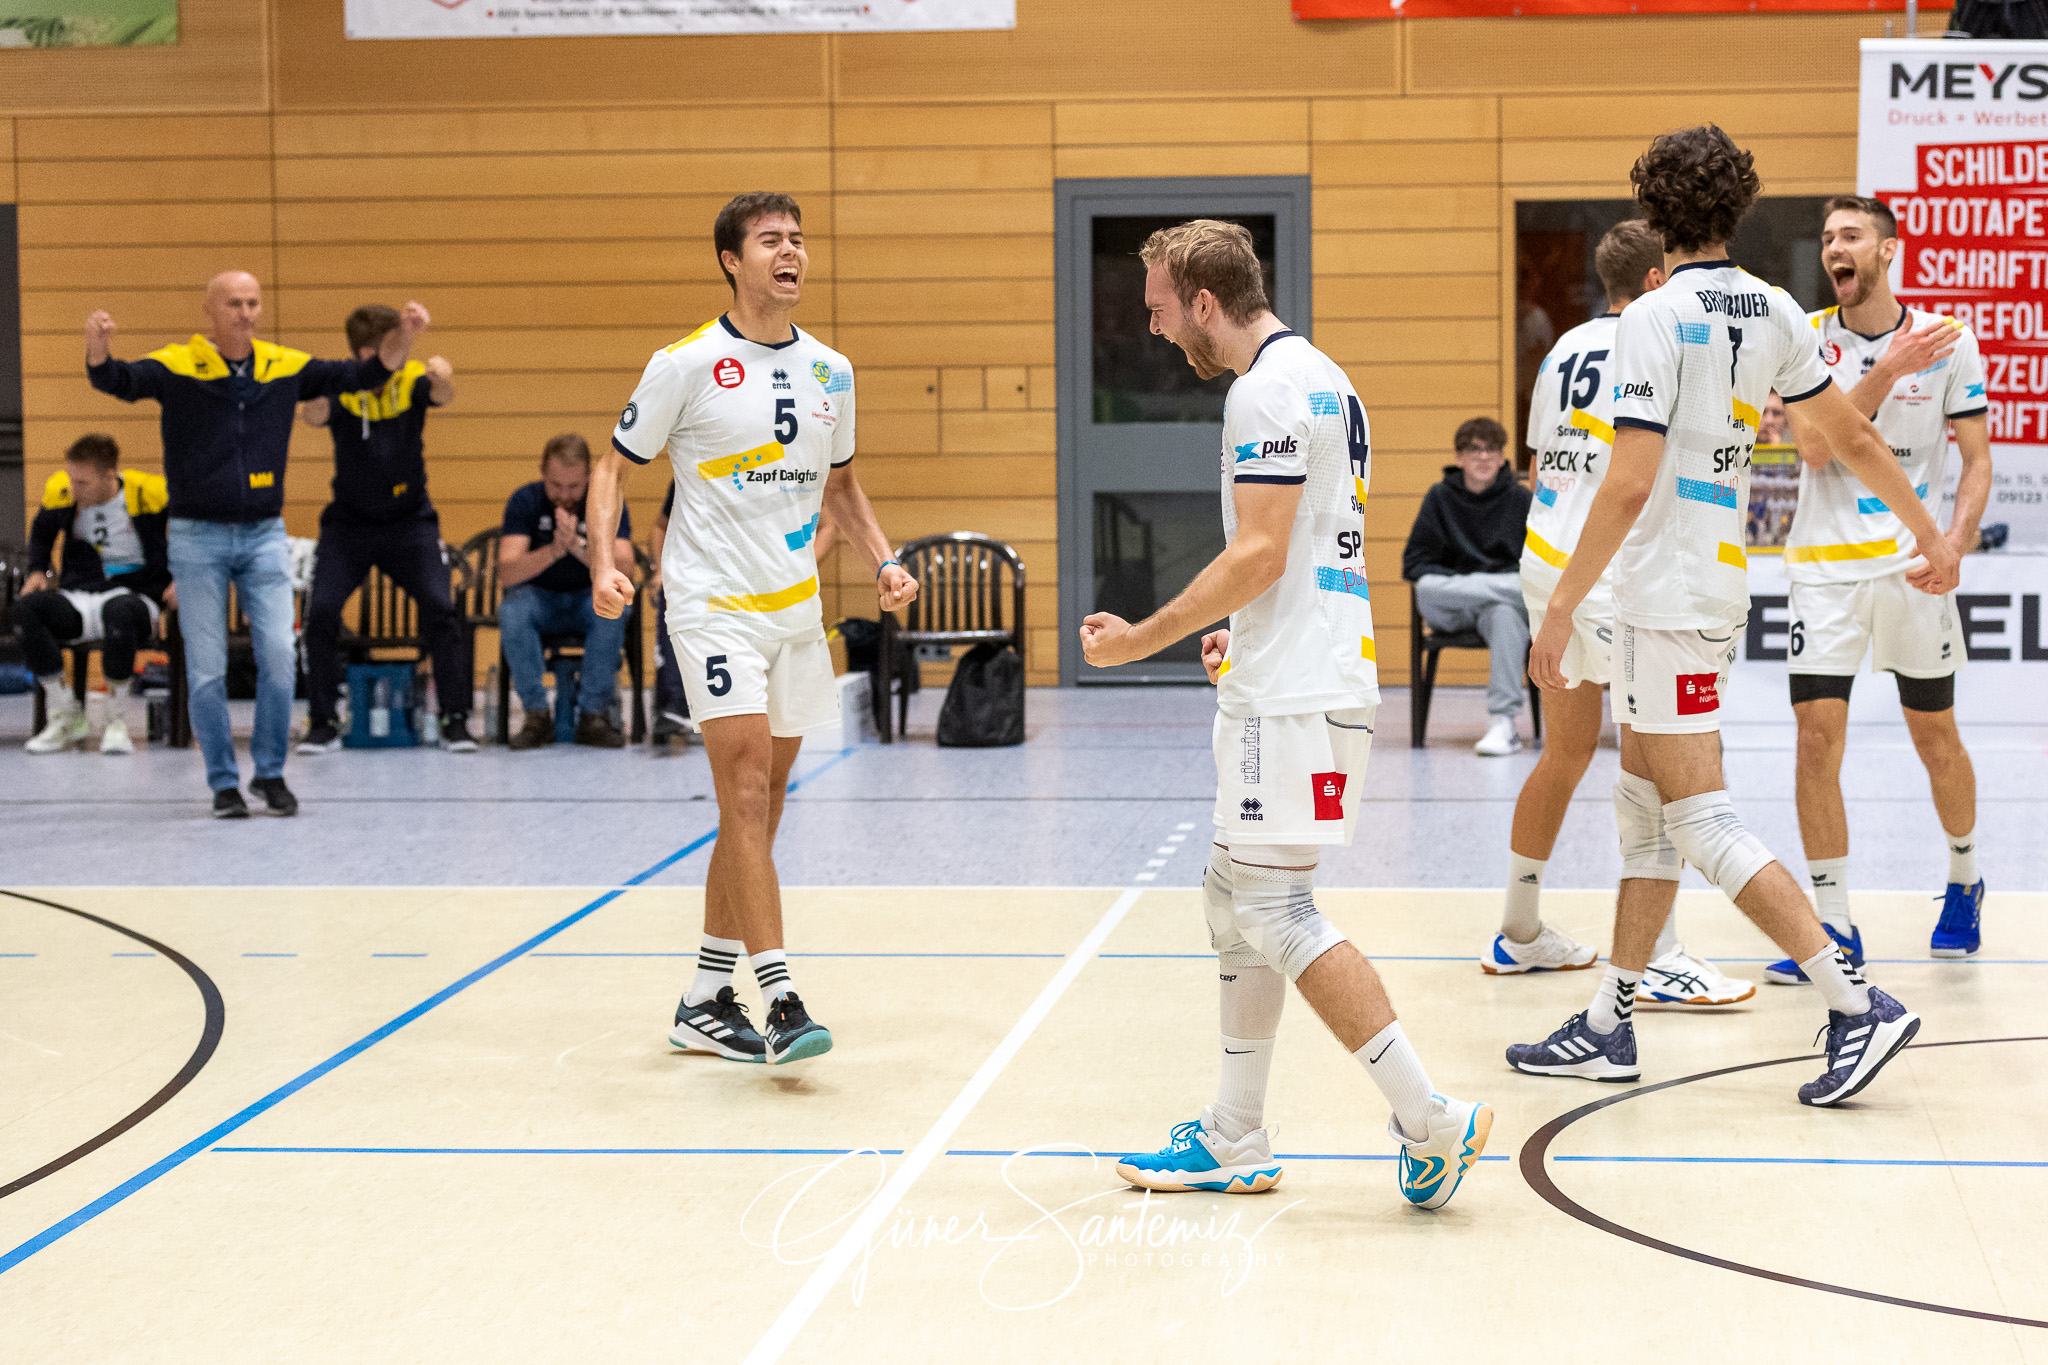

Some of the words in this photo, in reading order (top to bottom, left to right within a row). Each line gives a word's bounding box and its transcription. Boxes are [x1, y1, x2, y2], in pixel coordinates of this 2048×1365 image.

[1890, 63, 2048, 100] MEYS
[1888, 109, 1947, 126] Druck
[1889, 196, 2048, 237] FOTOTAPE
[1917, 249, 2048, 290] SCHRIFT
[1557, 349, 1610, 412] 15
[1624, 381, 1654, 398] puls
[774, 398, 799, 445] 5
[1262, 436, 1298, 458] puls
[746, 469, 777, 484] Zapf
[706, 655, 732, 697] 5
[1240, 813, 1263, 821] errea
